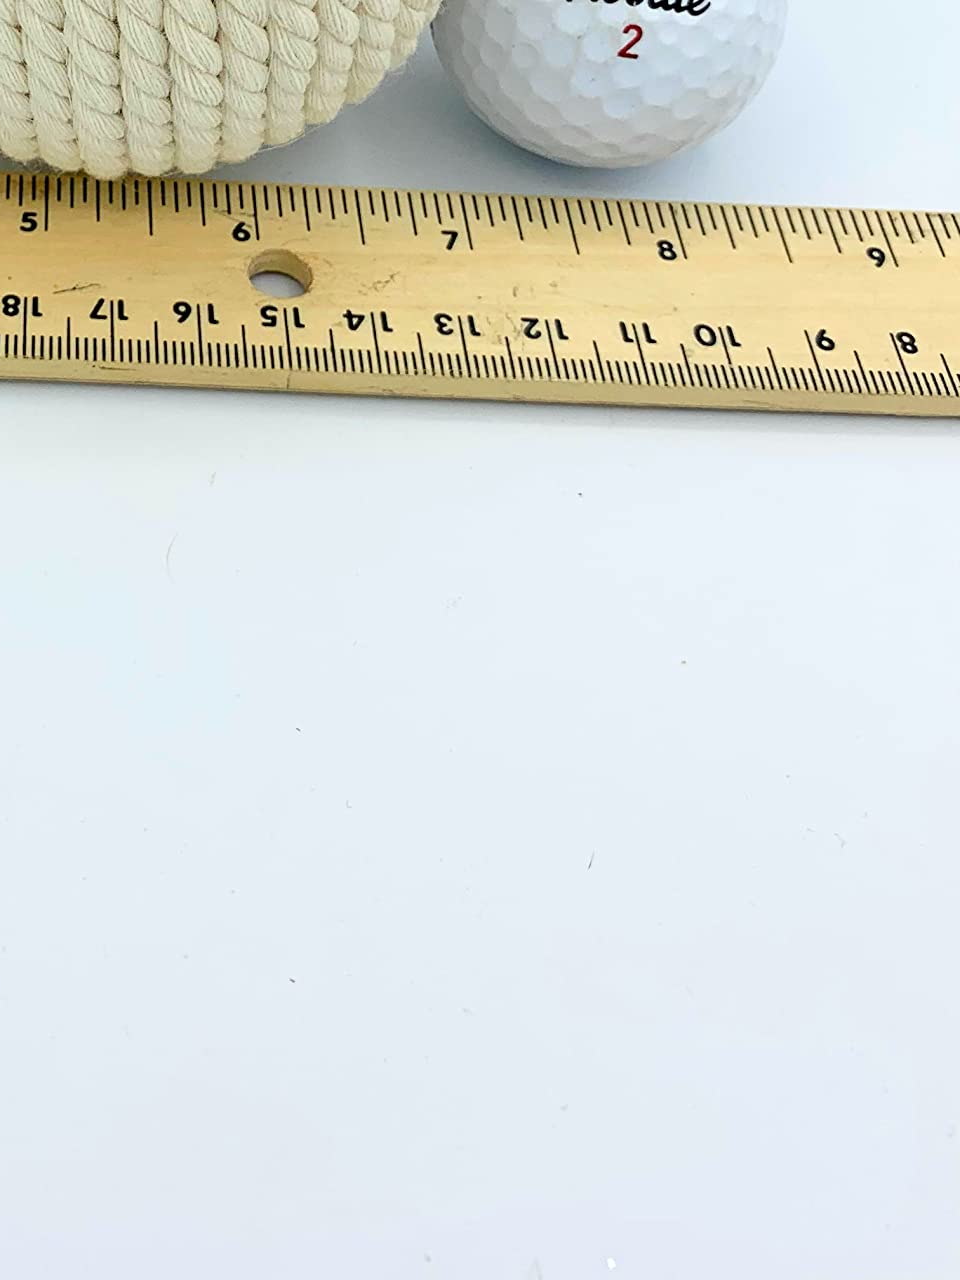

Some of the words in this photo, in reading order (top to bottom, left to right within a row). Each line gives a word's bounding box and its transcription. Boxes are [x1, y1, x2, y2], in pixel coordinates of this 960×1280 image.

[617, 24, 643, 60] 2
[19, 211, 38, 232] 5
[231, 222, 251, 242] 6
[441, 230, 458, 250] 7
[656, 239, 677, 261] 8
[866, 247, 886, 268] 9
[1, 294, 43, 317] 18
[89, 298, 129, 321] 17
[172, 301, 220, 325] 16
[260, 305, 306, 328] 15
[342, 309, 394, 332] 14
[433, 313, 481, 337] 13
[520, 317, 569, 341] 12
[619, 321, 657, 344] 11
[693, 323, 742, 347] 10
[815, 328, 836, 351] 9
[895, 331, 919, 355] 8
